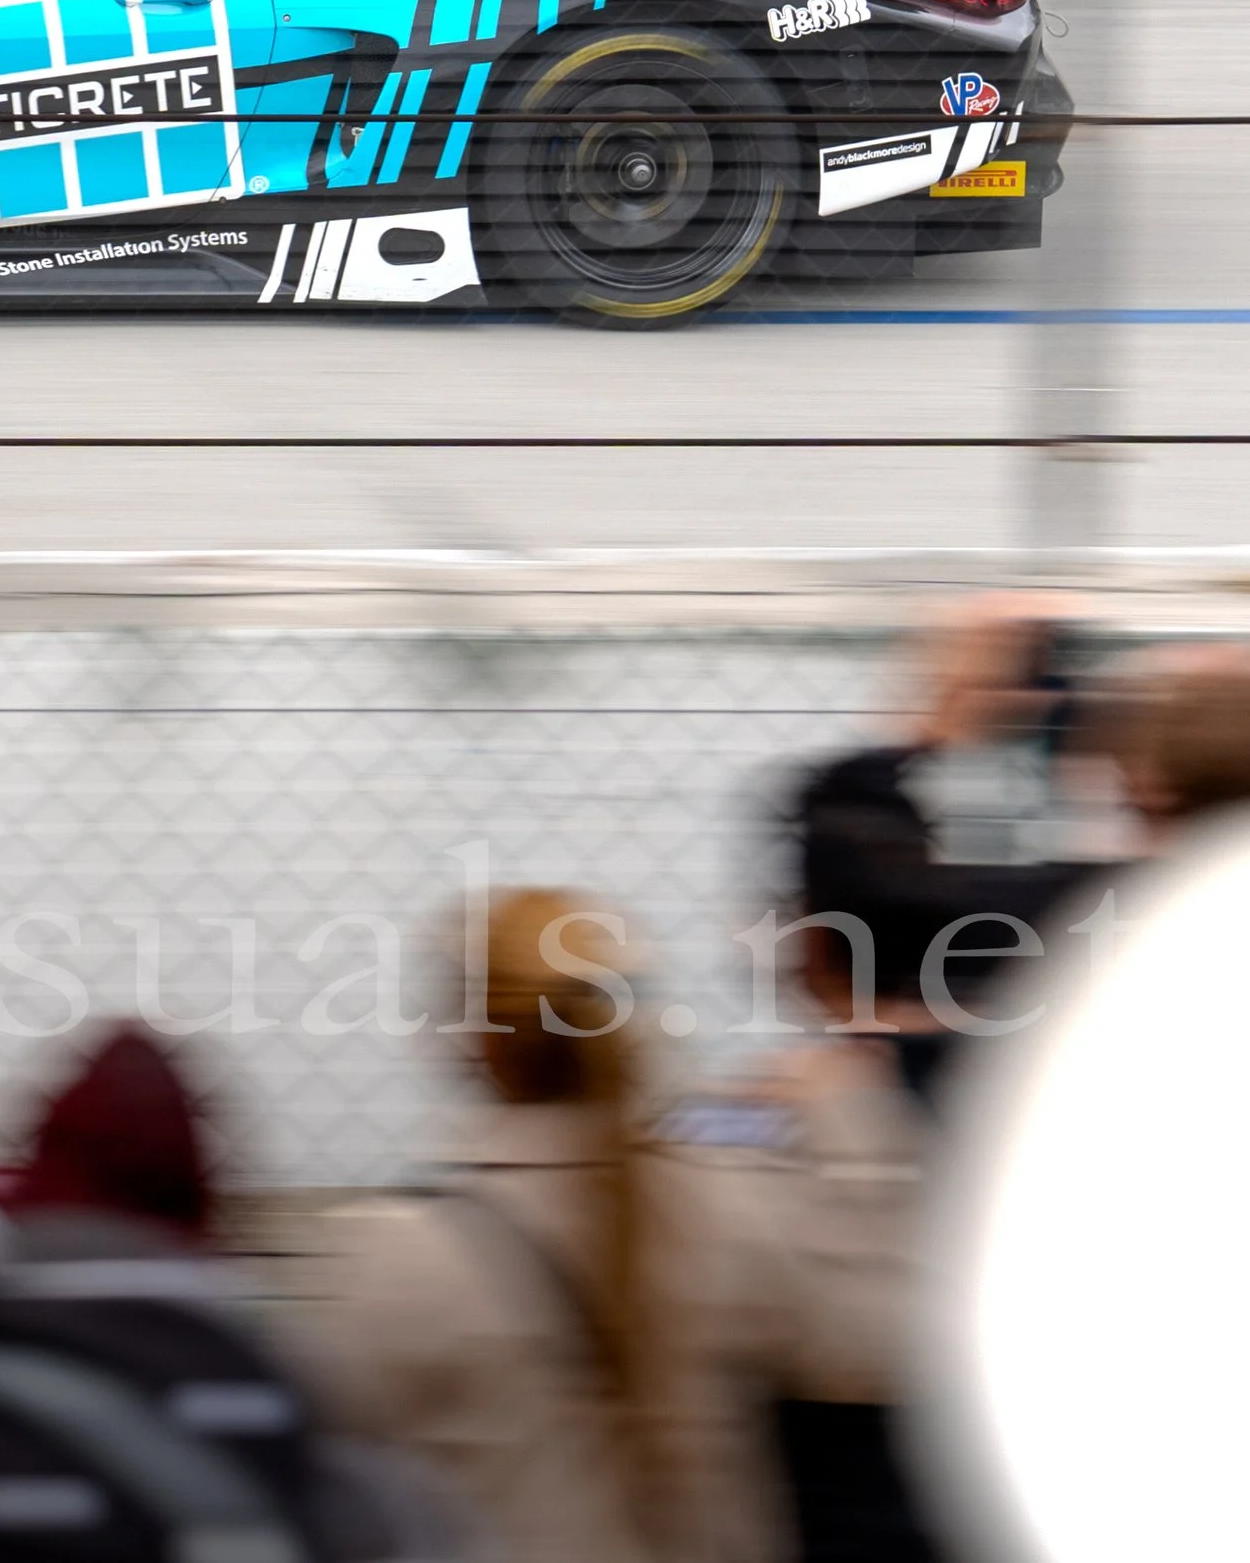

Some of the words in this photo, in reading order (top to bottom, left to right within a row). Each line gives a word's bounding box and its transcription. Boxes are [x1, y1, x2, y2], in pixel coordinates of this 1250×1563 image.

[942, 73, 983, 116] VP
[827, 142, 927, 167] andyblackmoredesign
[55, 239, 164, 267] Installation
[167, 231, 248, 253] Systems
